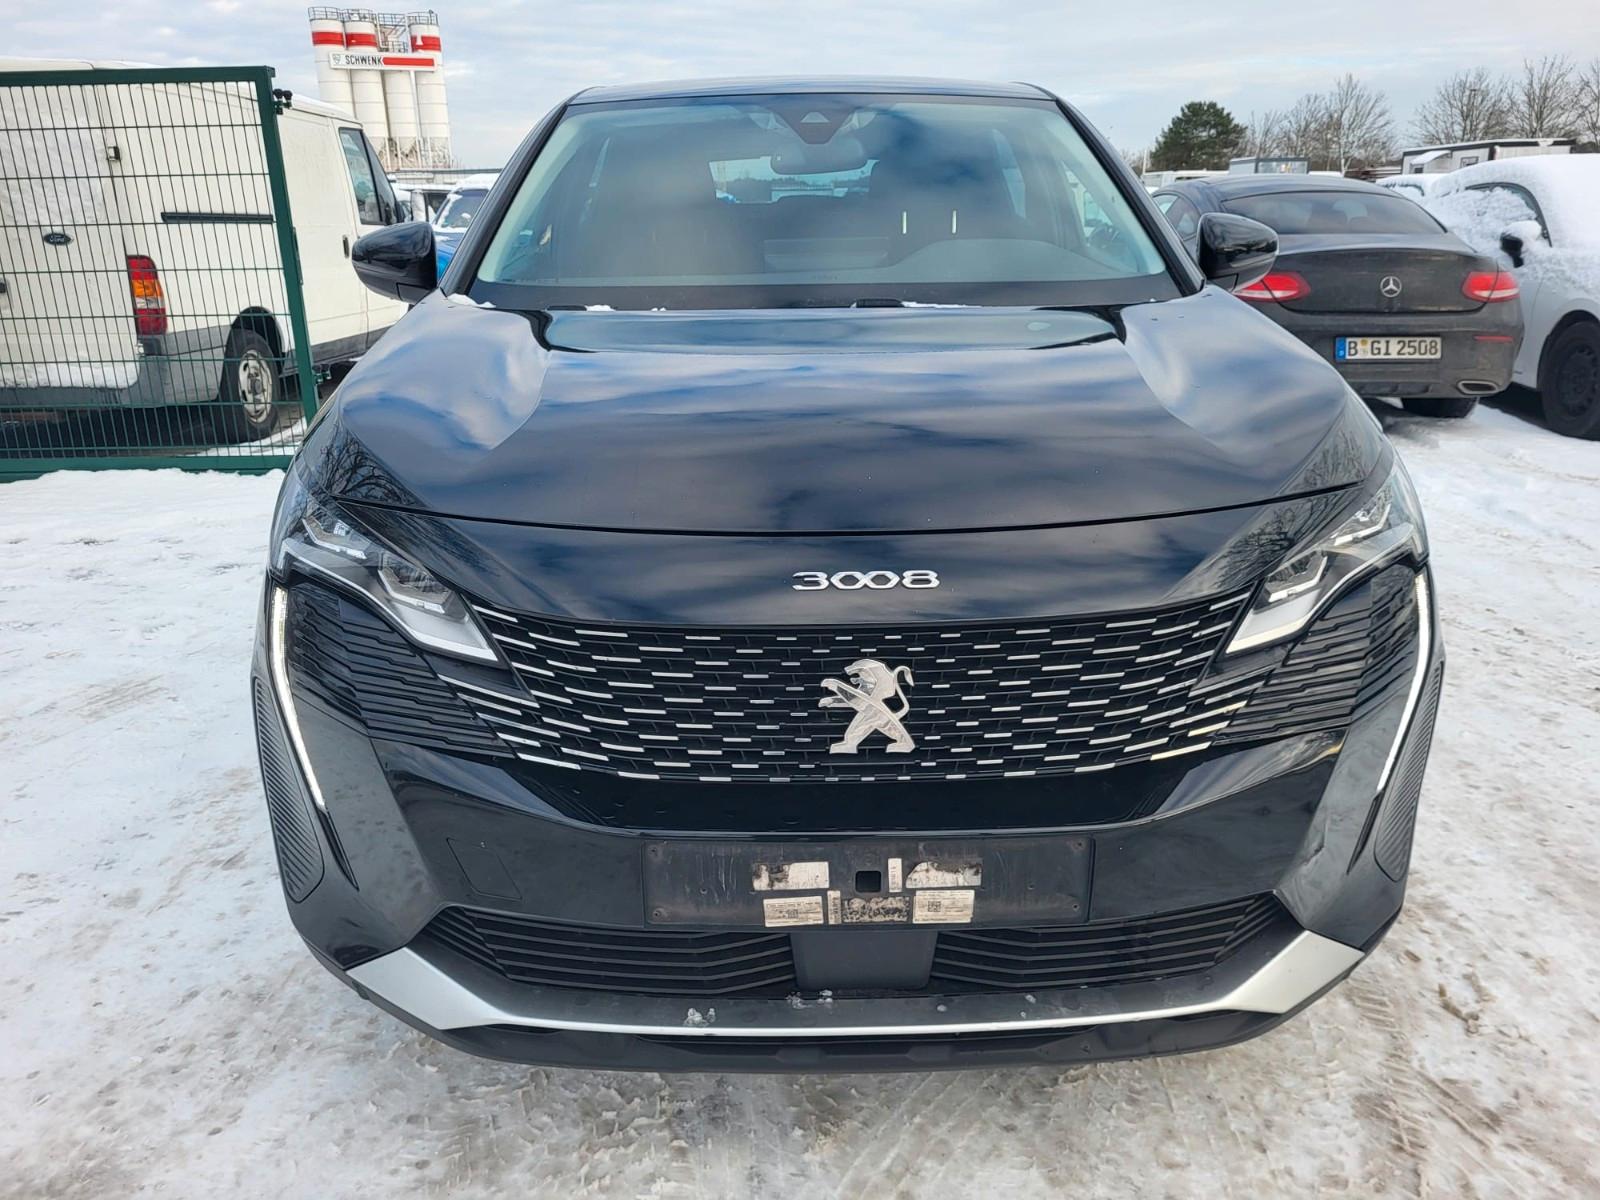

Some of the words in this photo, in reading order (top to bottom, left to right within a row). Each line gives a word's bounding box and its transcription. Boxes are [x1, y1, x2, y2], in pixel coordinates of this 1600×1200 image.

[345, 54, 383, 66] SCHWENK
[1347, 340, 1359, 357] B
[1370, 340, 1391, 356] GI
[1396, 340, 1438, 356] 2508
[792, 569, 940, 591] 3008
